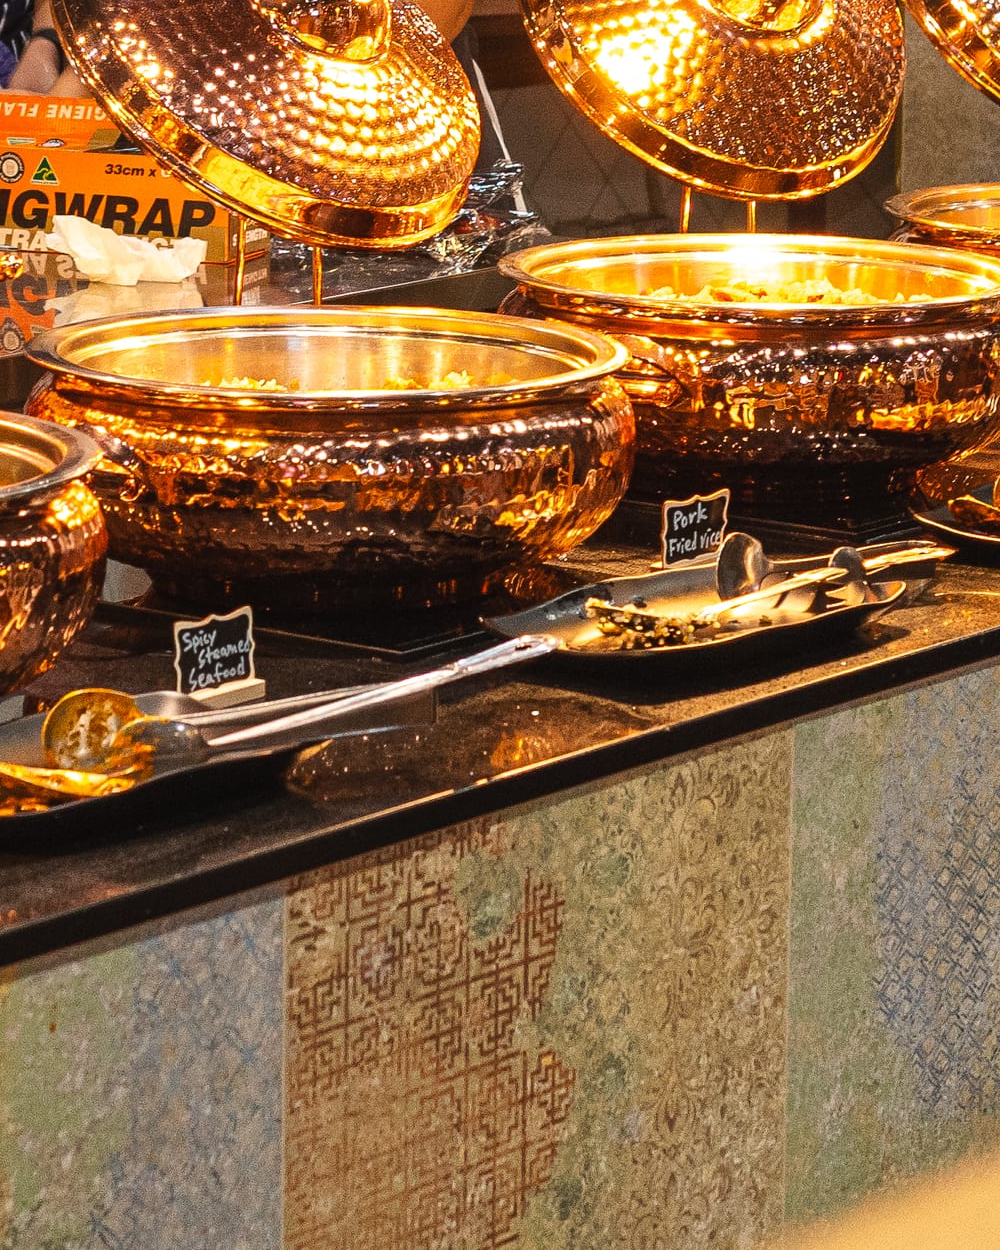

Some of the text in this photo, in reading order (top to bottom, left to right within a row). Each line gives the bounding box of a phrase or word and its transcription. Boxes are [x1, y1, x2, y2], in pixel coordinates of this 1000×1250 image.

[45, 104, 107, 121] GIENE
[104, 163, 145, 177] 33cm
[148, 168, 157, 178] x
[672, 501, 709, 531] Pork
[668, 530, 698, 557] Fried
[181, 629, 217, 653] Spicy
